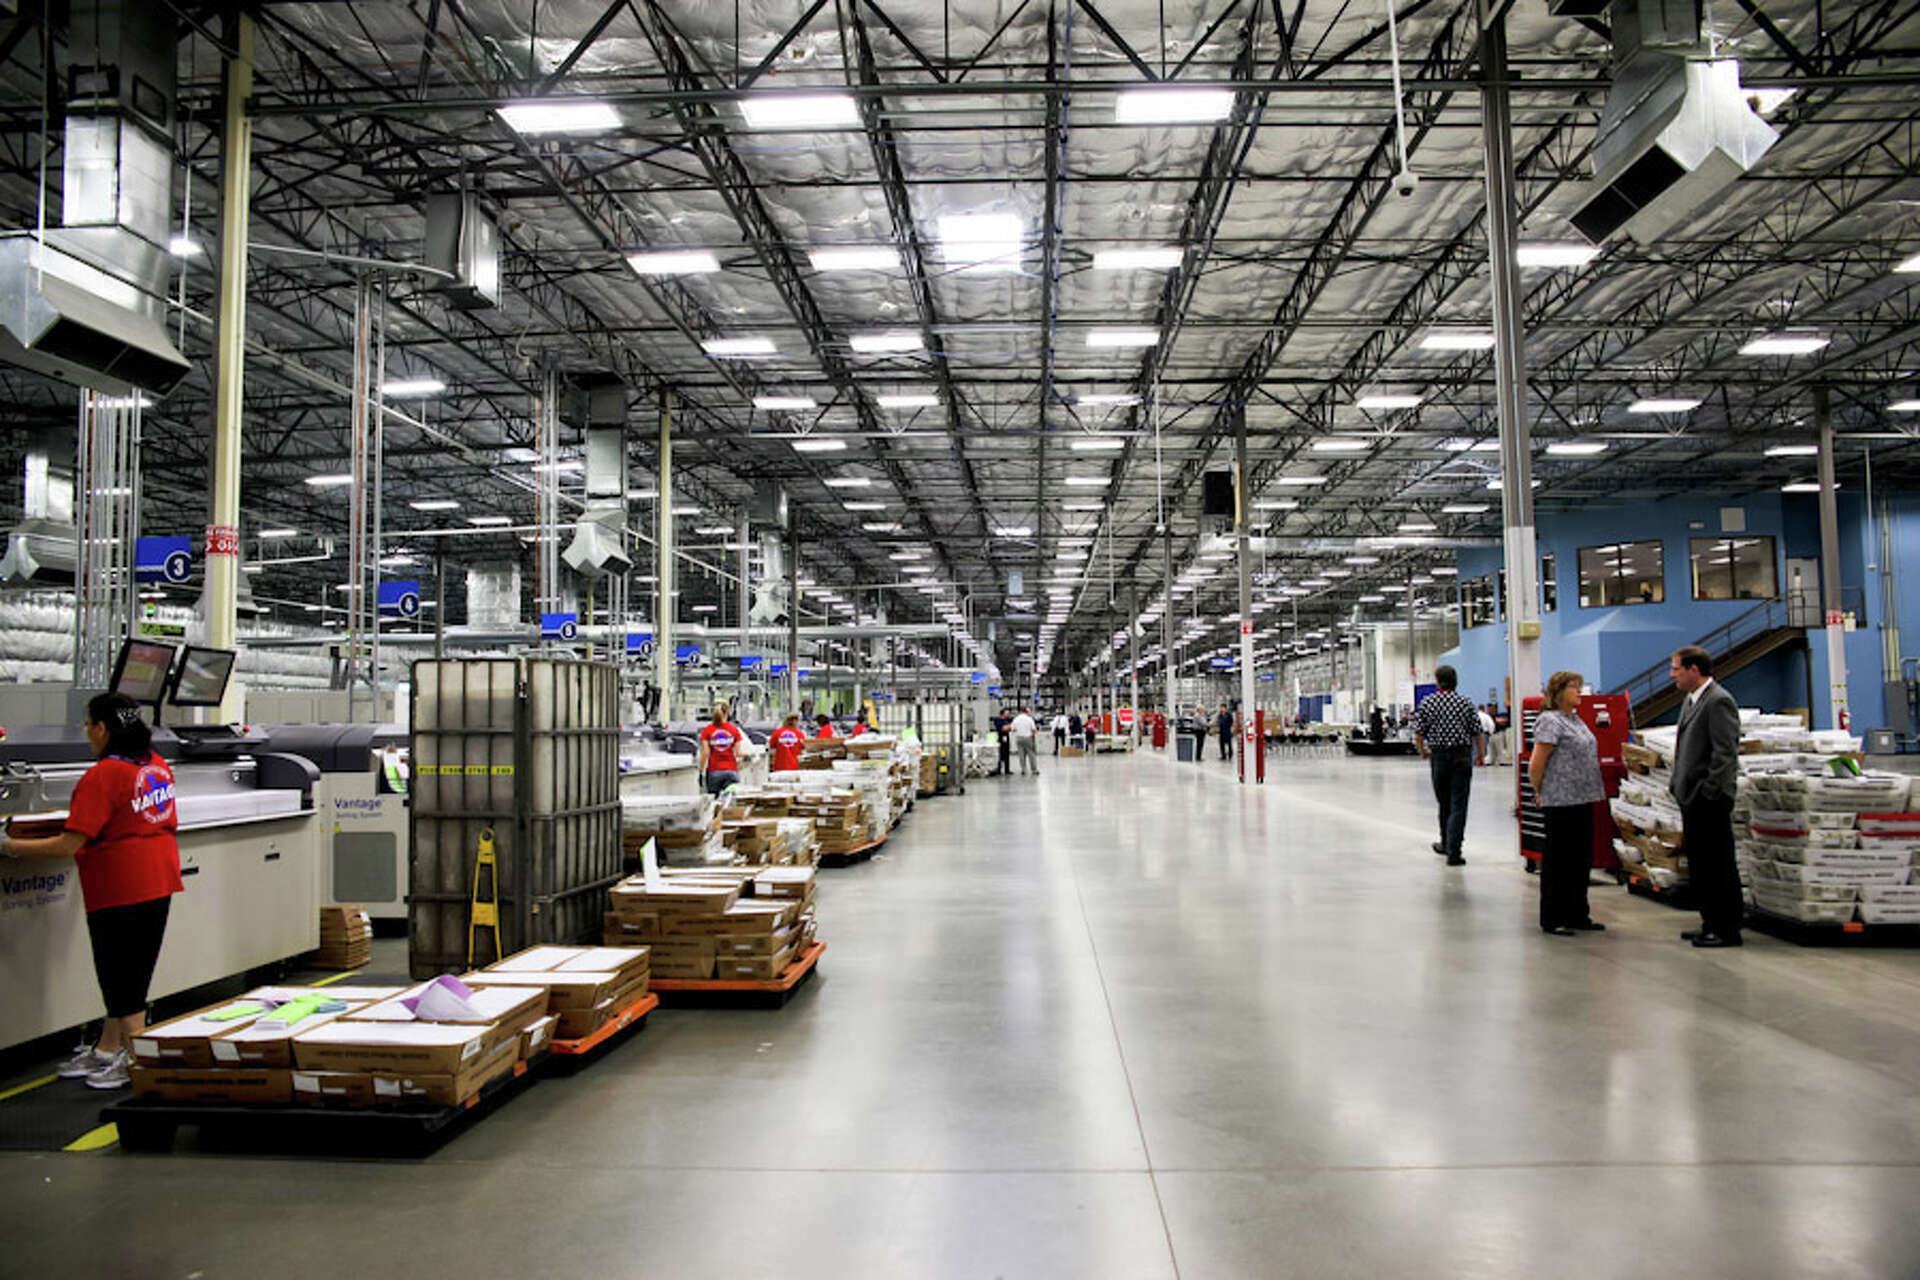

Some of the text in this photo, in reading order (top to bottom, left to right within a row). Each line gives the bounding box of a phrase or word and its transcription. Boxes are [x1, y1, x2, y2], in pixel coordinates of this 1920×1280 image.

[174, 558, 184, 576] 3
[334, 797, 383, 811] Vantage
[1, 872, 65, 894] Vantage
